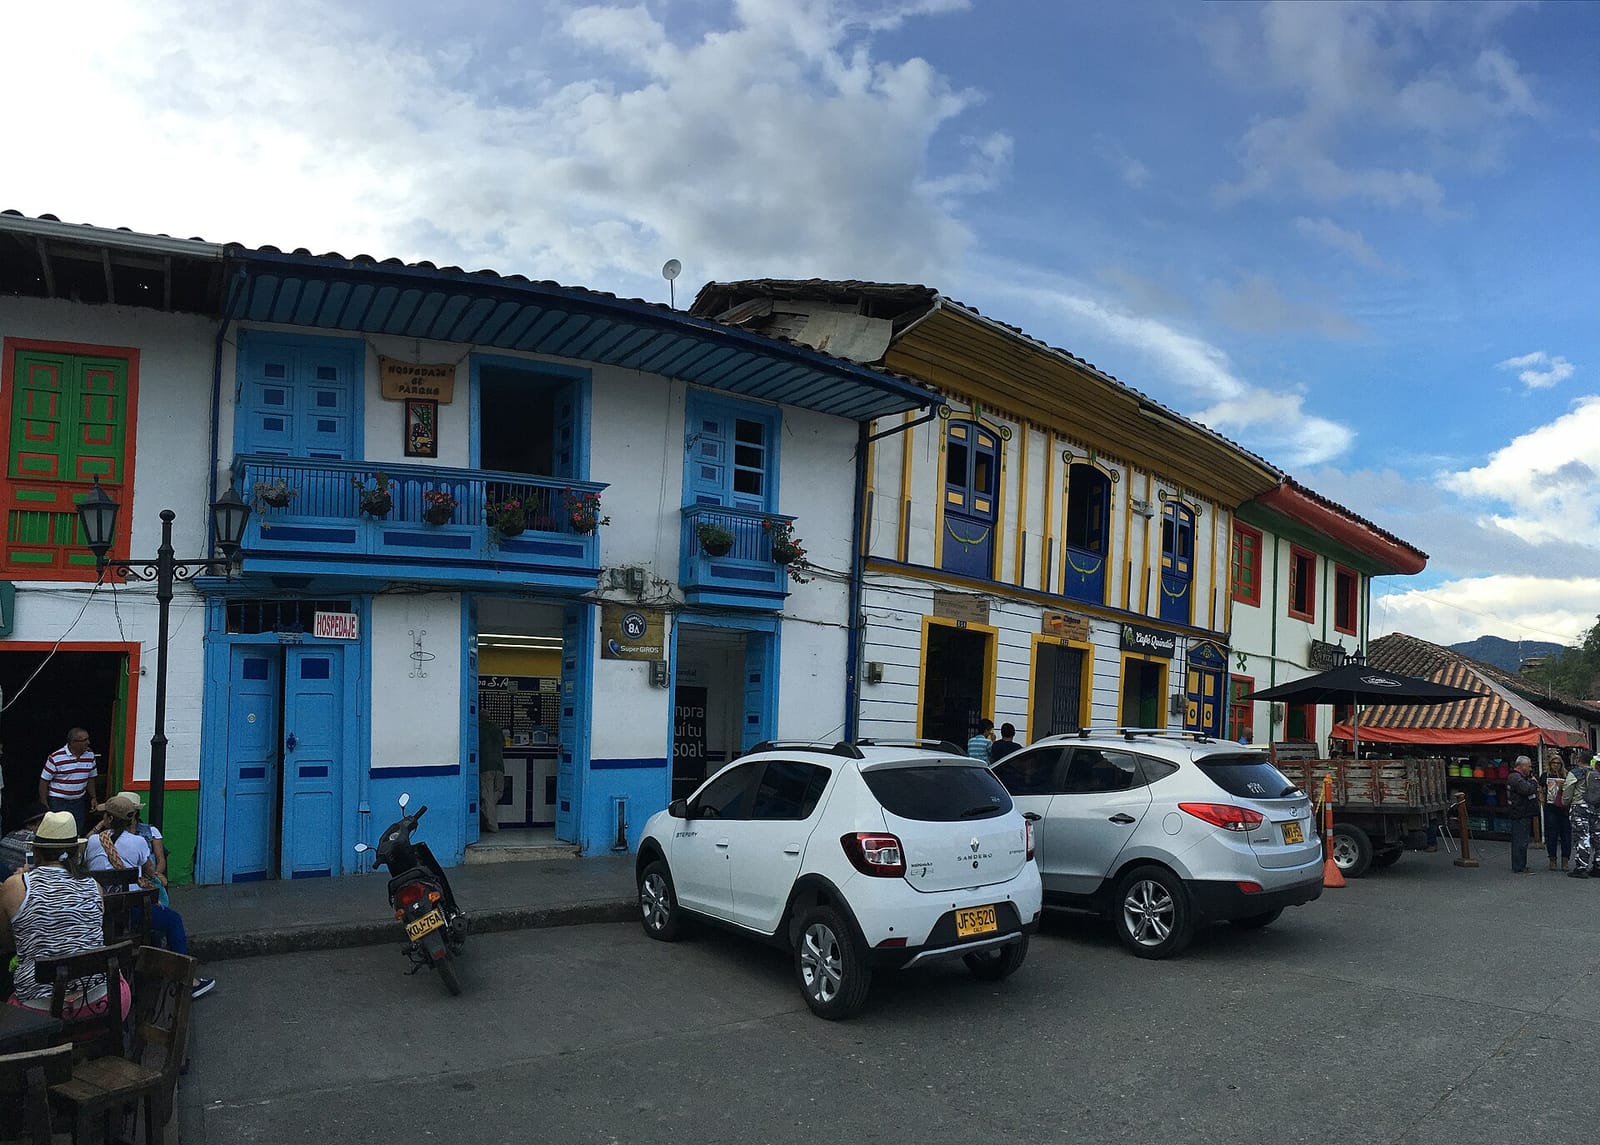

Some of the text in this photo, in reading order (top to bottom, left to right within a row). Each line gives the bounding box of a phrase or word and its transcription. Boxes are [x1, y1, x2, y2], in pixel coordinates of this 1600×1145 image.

[388, 365, 446, 377] HOSPEDAJE
[398, 385, 440, 395] PARQUE
[316, 614, 356, 638] HOSPEDAJE
[1136, 631, 1151, 646] Café
[620, 645, 659, 653] SuperGIROS
[673, 740, 704, 758] soat
[957, 852, 993, 862] SANDERO
